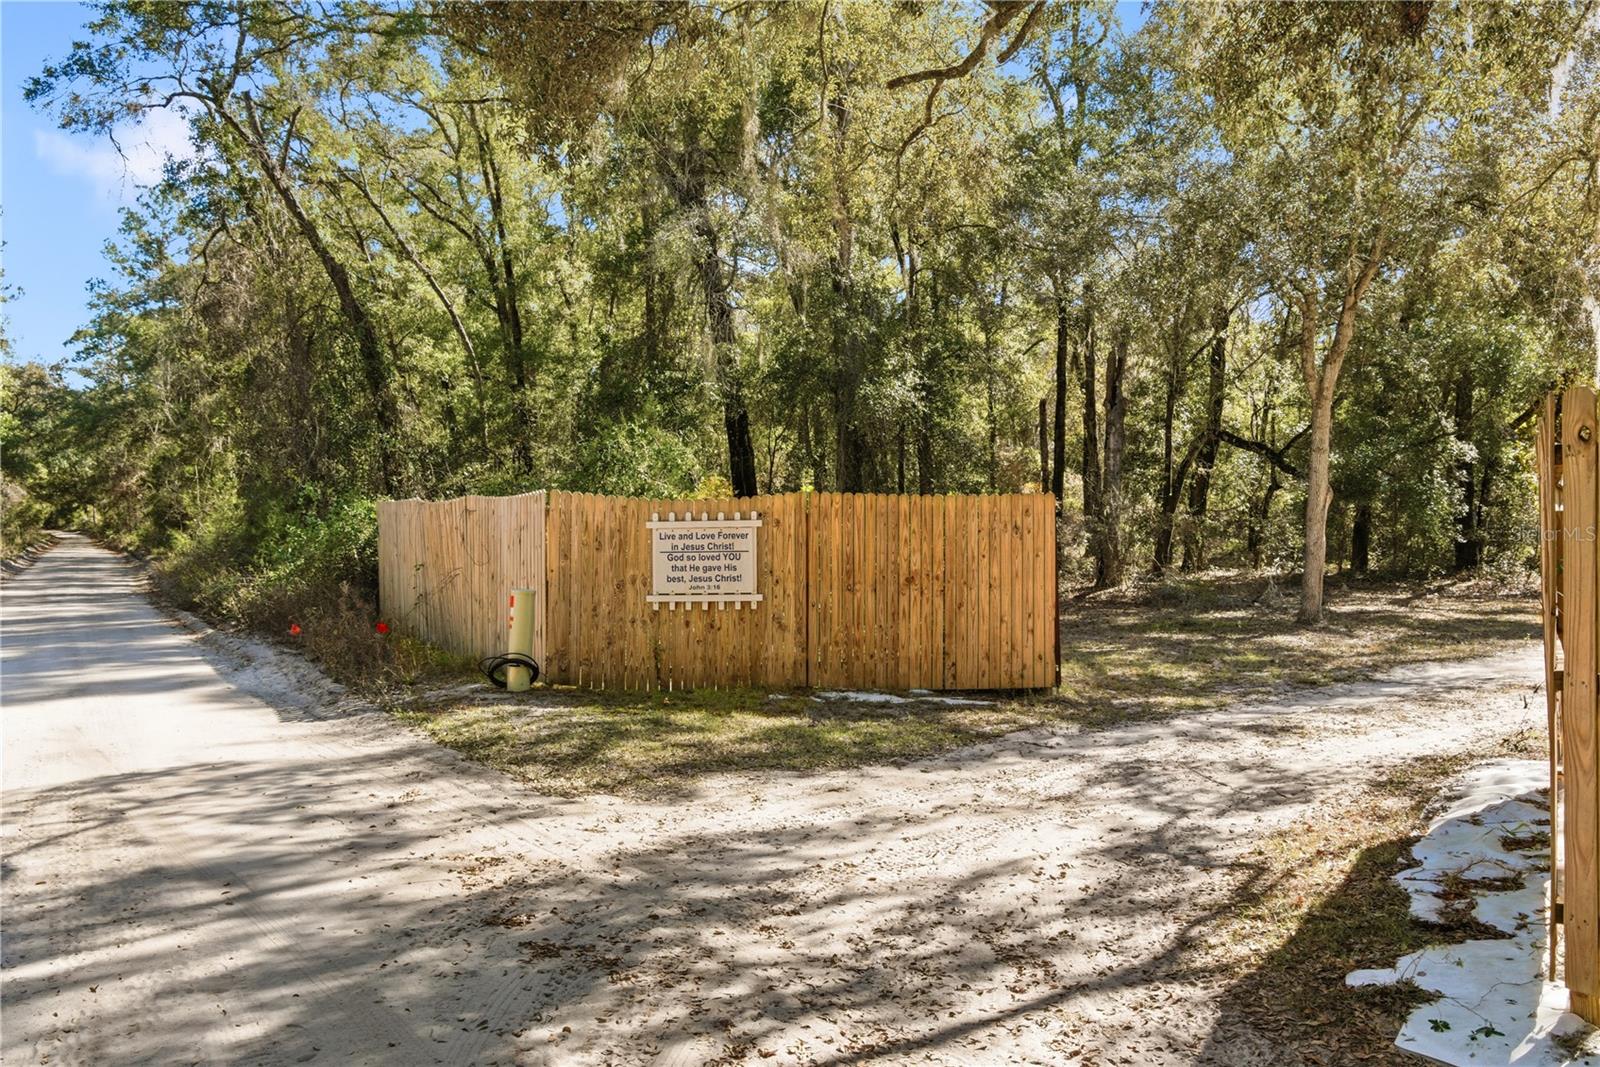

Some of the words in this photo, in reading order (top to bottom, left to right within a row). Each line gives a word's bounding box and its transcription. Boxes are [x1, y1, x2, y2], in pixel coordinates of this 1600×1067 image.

[659, 532, 676, 540] Live
[718, 532, 749, 540] Forever
[702, 566, 721, 574] gave
[666, 575, 686, 583] best,
